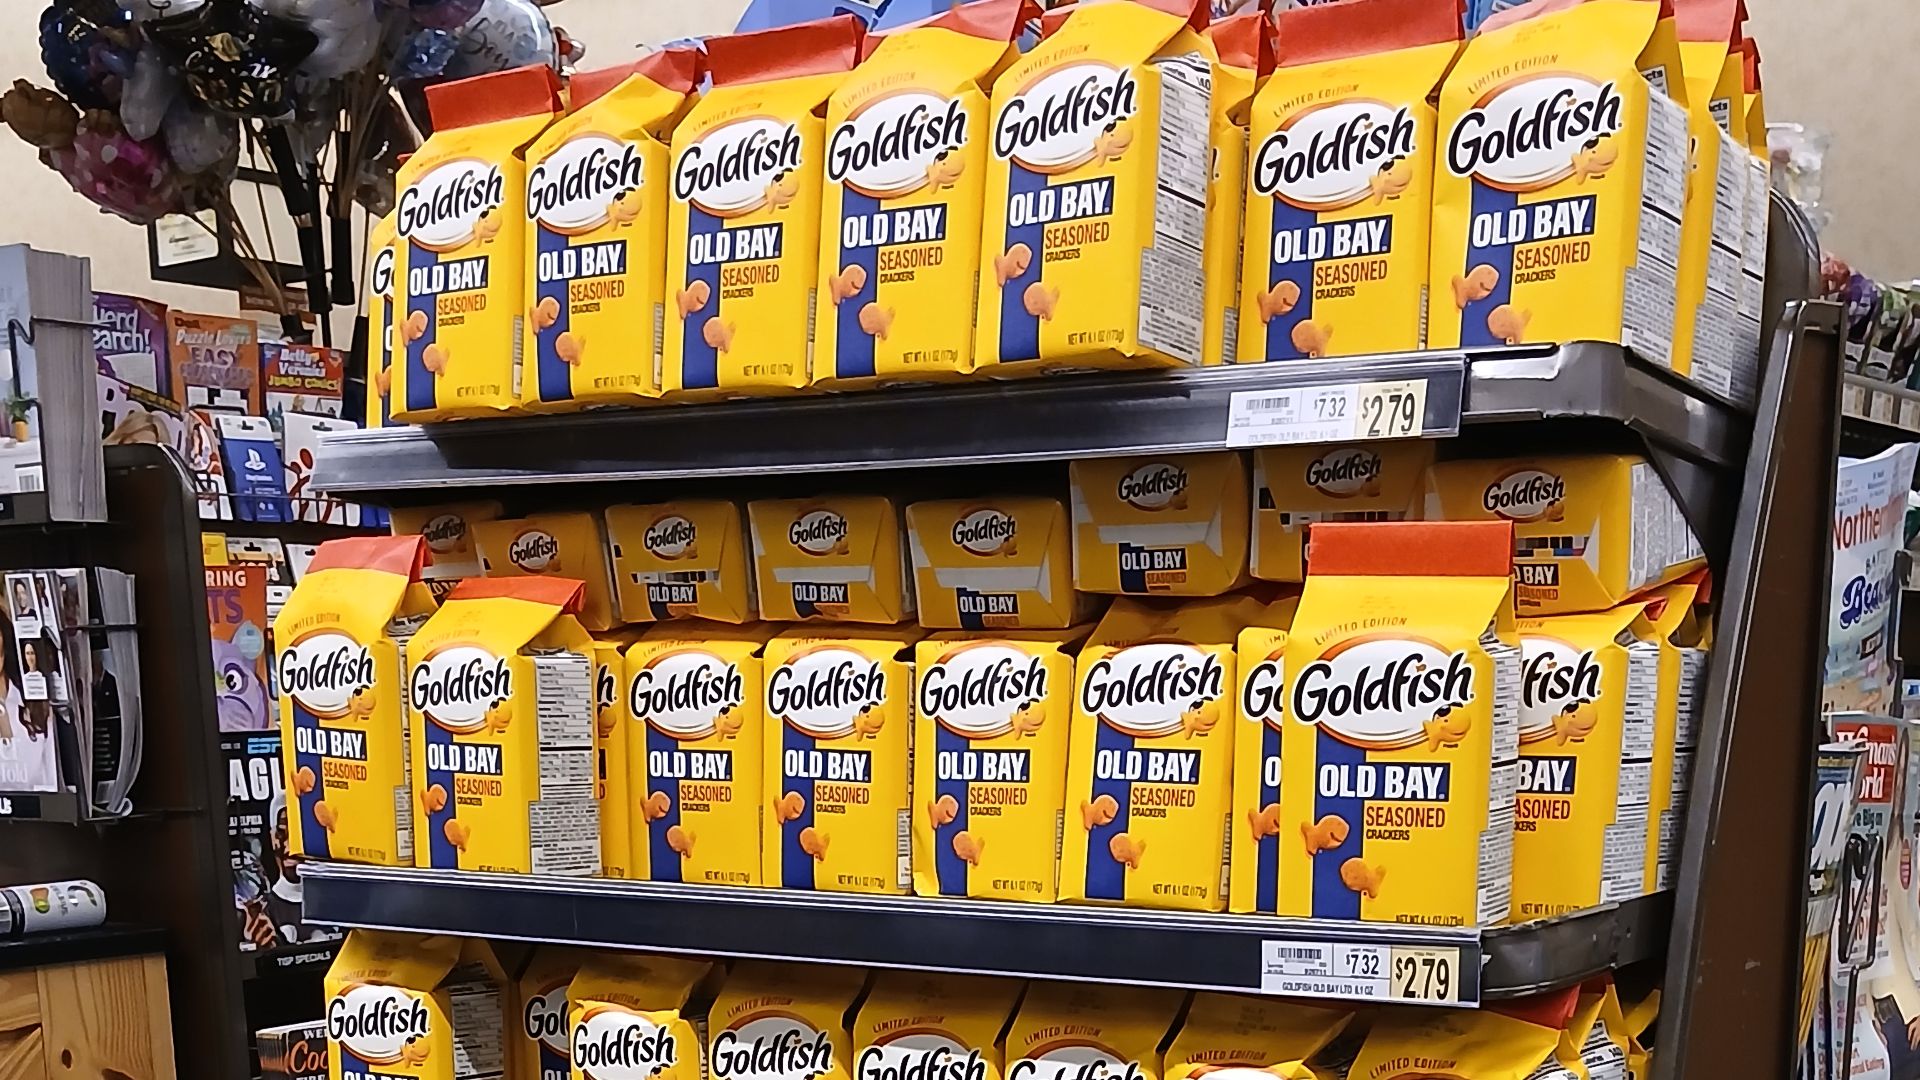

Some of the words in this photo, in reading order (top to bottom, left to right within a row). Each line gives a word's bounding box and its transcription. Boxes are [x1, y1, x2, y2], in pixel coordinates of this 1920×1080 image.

[1468, 65, 1510, 94] LIMITED
[1514, 54, 1558, 70] EDITION
[996, 69, 1136, 158] Goldfish
[1274, 92, 1313, 117] LIMITED
[1318, 83, 1359, 99] EDITION
[828, 100, 966, 180] Goldfish
[1448, 82, 1622, 175] Goldfish
[676, 123, 801, 200] Goldfish
[1254, 107, 1415, 193] Goldfish
[527, 144, 642, 220] Goldfish
[398, 165, 502, 237] Goldfish
[1010, 190, 1054, 226] OLD
[1060, 180, 1112, 218] BAY
[844, 216, 889, 248] OLD
[894, 208, 942, 243] BAY
[1045, 222, 1109, 248] SEASONED
[1472, 208, 1527, 248] OLD
[1533, 199, 1591, 238] BAY
[690, 233, 730, 265] OLD
[736, 226, 779, 261] BAY
[1274, 226, 1328, 264] OLD
[1332, 219, 1387, 258] BAY
[1515, 240, 1590, 270] SEASONED
[539, 249, 576, 282] OLD
[581, 243, 624, 274] BAY
[880, 246, 943, 270] SEASONED
[1316, 260, 1387, 286] SEASONED
[410, 266, 444, 296] OLD
[448, 259, 487, 292] BAY
[722, 264, 779, 287] SEASONED
[1515, 269, 1556, 284] CRACKERS
[438, 294, 486, 315] SEASONED
[570, 280, 624, 302] SEASONED
[1316, 286, 1355, 300] CRACKERS
[1119, 468, 1188, 500] Goldfish
[1306, 454, 1382, 486] Goldfish
[1484, 476, 1564, 510] Goldfish
[644, 522, 696, 549] Goldfish
[790, 516, 847, 545] Goldfish
[953, 515, 1016, 546] Goldfish
[1832, 498, 1890, 550] Northe
[510, 536, 558, 564] Goldfish
[1122, 552, 1150, 570] OLD
[1154, 551, 1182, 569] BAY
[206, 570, 246, 587] RING
[1523, 566, 1554, 584] BAY
[207, 588, 244, 623] TS
[649, 586, 670, 602] OLD
[672, 586, 694, 602] BAY
[795, 585, 818, 602] OLD
[820, 586, 845, 603] BAY
[960, 596, 986, 613] OLD
[989, 596, 1014, 613] BAY
[1315, 622, 1358, 645] LIMITED
[1363, 616, 1408, 629] EDITION
[280, 646, 373, 693] Goldfish
[412, 658, 511, 709] Goldfish
[1083, 654, 1222, 712] Goldfish
[1522, 651, 1598, 708] fish
[631, 662, 742, 718] Goldfish
[768, 662, 884, 714] Goldfish
[921, 656, 1046, 716] Goldfish
[1294, 650, 1472, 722] Goldfish
[296, 727, 326, 755] OLD
[330, 730, 365, 759] BAY
[1837, 726, 1896, 765] man's
[324, 761, 366, 780] SEASONED
[428, 744, 460, 770] OLD
[465, 745, 498, 774] BAY
[650, 750, 686, 778] OLD
[690, 752, 728, 780] BAY
[785, 750, 822, 778] OLD
[828, 753, 867, 780] BAY
[939, 752, 977, 779] OLD
[982, 753, 1026, 780] BAY
[1096, 750, 1142, 780] OLD
[1148, 753, 1196, 782] BAY
[456, 778, 502, 796] SEASONED
[1320, 764, 1376, 798] OLD
[1384, 766, 1443, 799] BAY
[1517, 760, 1570, 792] BAY
[681, 785, 732, 802] SEASONED
[816, 785, 869, 804] SEASONED
[970, 787, 1028, 806] SEASONED
[1132, 786, 1195, 808] SEASONED
[1132, 808, 1166, 818] CRACKERS
[1366, 807, 1446, 828] SEASONED
[1515, 798, 1570, 820] ASONED
[1366, 830, 1410, 840] CRACKERS
[1282, 982, 1312, 991] GOLDFISH
[1326, 984, 1339, 993] BAY
[1340, 984, 1352, 994] LTD
[1364, 986, 1374, 995] OZ
[1396, 957, 1450, 1000] $2.79
[328, 996, 428, 1039] Goldfish
[728, 1000, 759, 1018] LIMITED
[872, 1018, 908, 1033] LIMITED
[1024, 1027, 1060, 1045] LIMITED
[574, 1024, 674, 1068] Goldfish
[712, 1030, 832, 1077] Goldfish
[1186, 1051, 1226, 1064] LIMITED
[1369, 1058, 1409, 1078] LIMITED
[1414, 1058, 1457, 1069] EDITION
